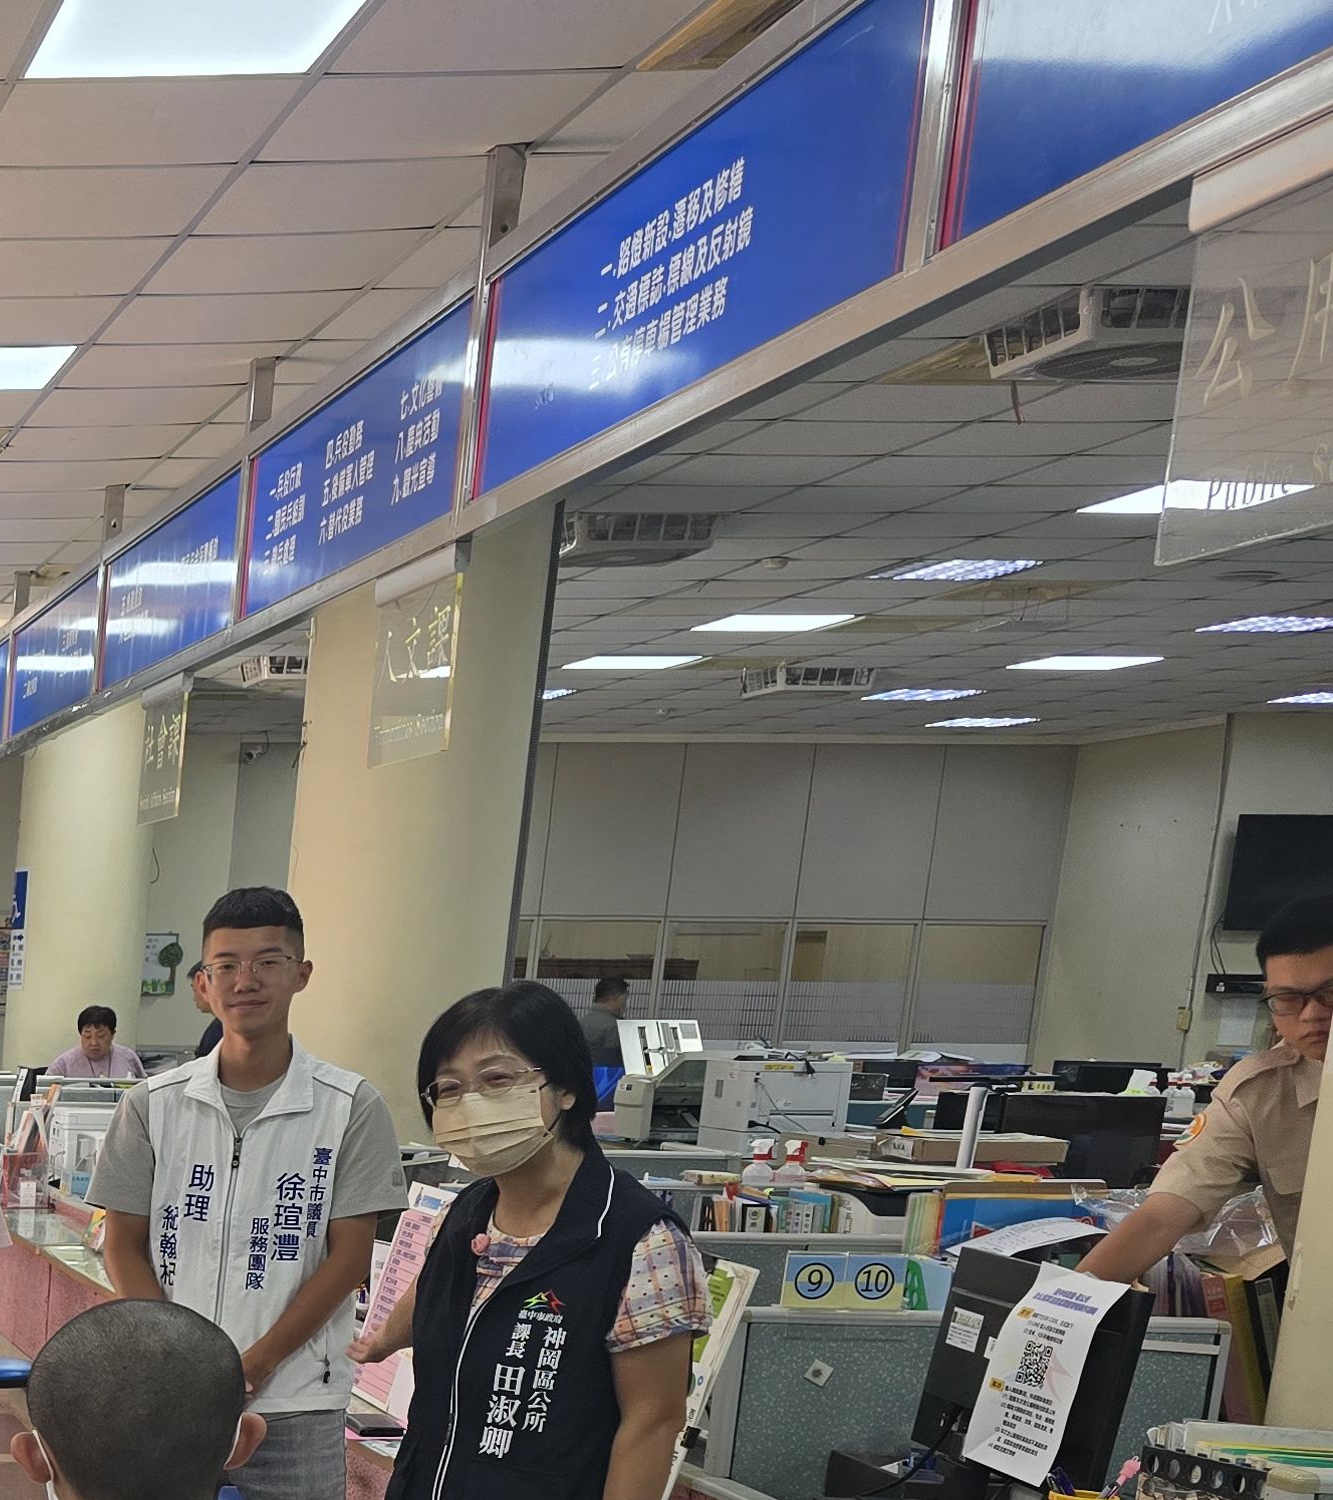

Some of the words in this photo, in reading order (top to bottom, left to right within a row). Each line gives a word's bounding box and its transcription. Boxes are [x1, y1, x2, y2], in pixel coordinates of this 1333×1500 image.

[183, 1163, 215, 1223] 助理
[305, 1146, 334, 1239] 臺中市議員
[245, 1216, 270, 1291] 服務團隊
[807, 1268, 824, 1292] 9
[860, 1269, 889, 1293] 10
[504, 1322, 533, 1360] 課長
[517, 1309, 565, 1325] 臺中市政府
[521, 1326, 568, 1433] 神岡區公所
[477, 1363, 526, 1460] 田淑卿
